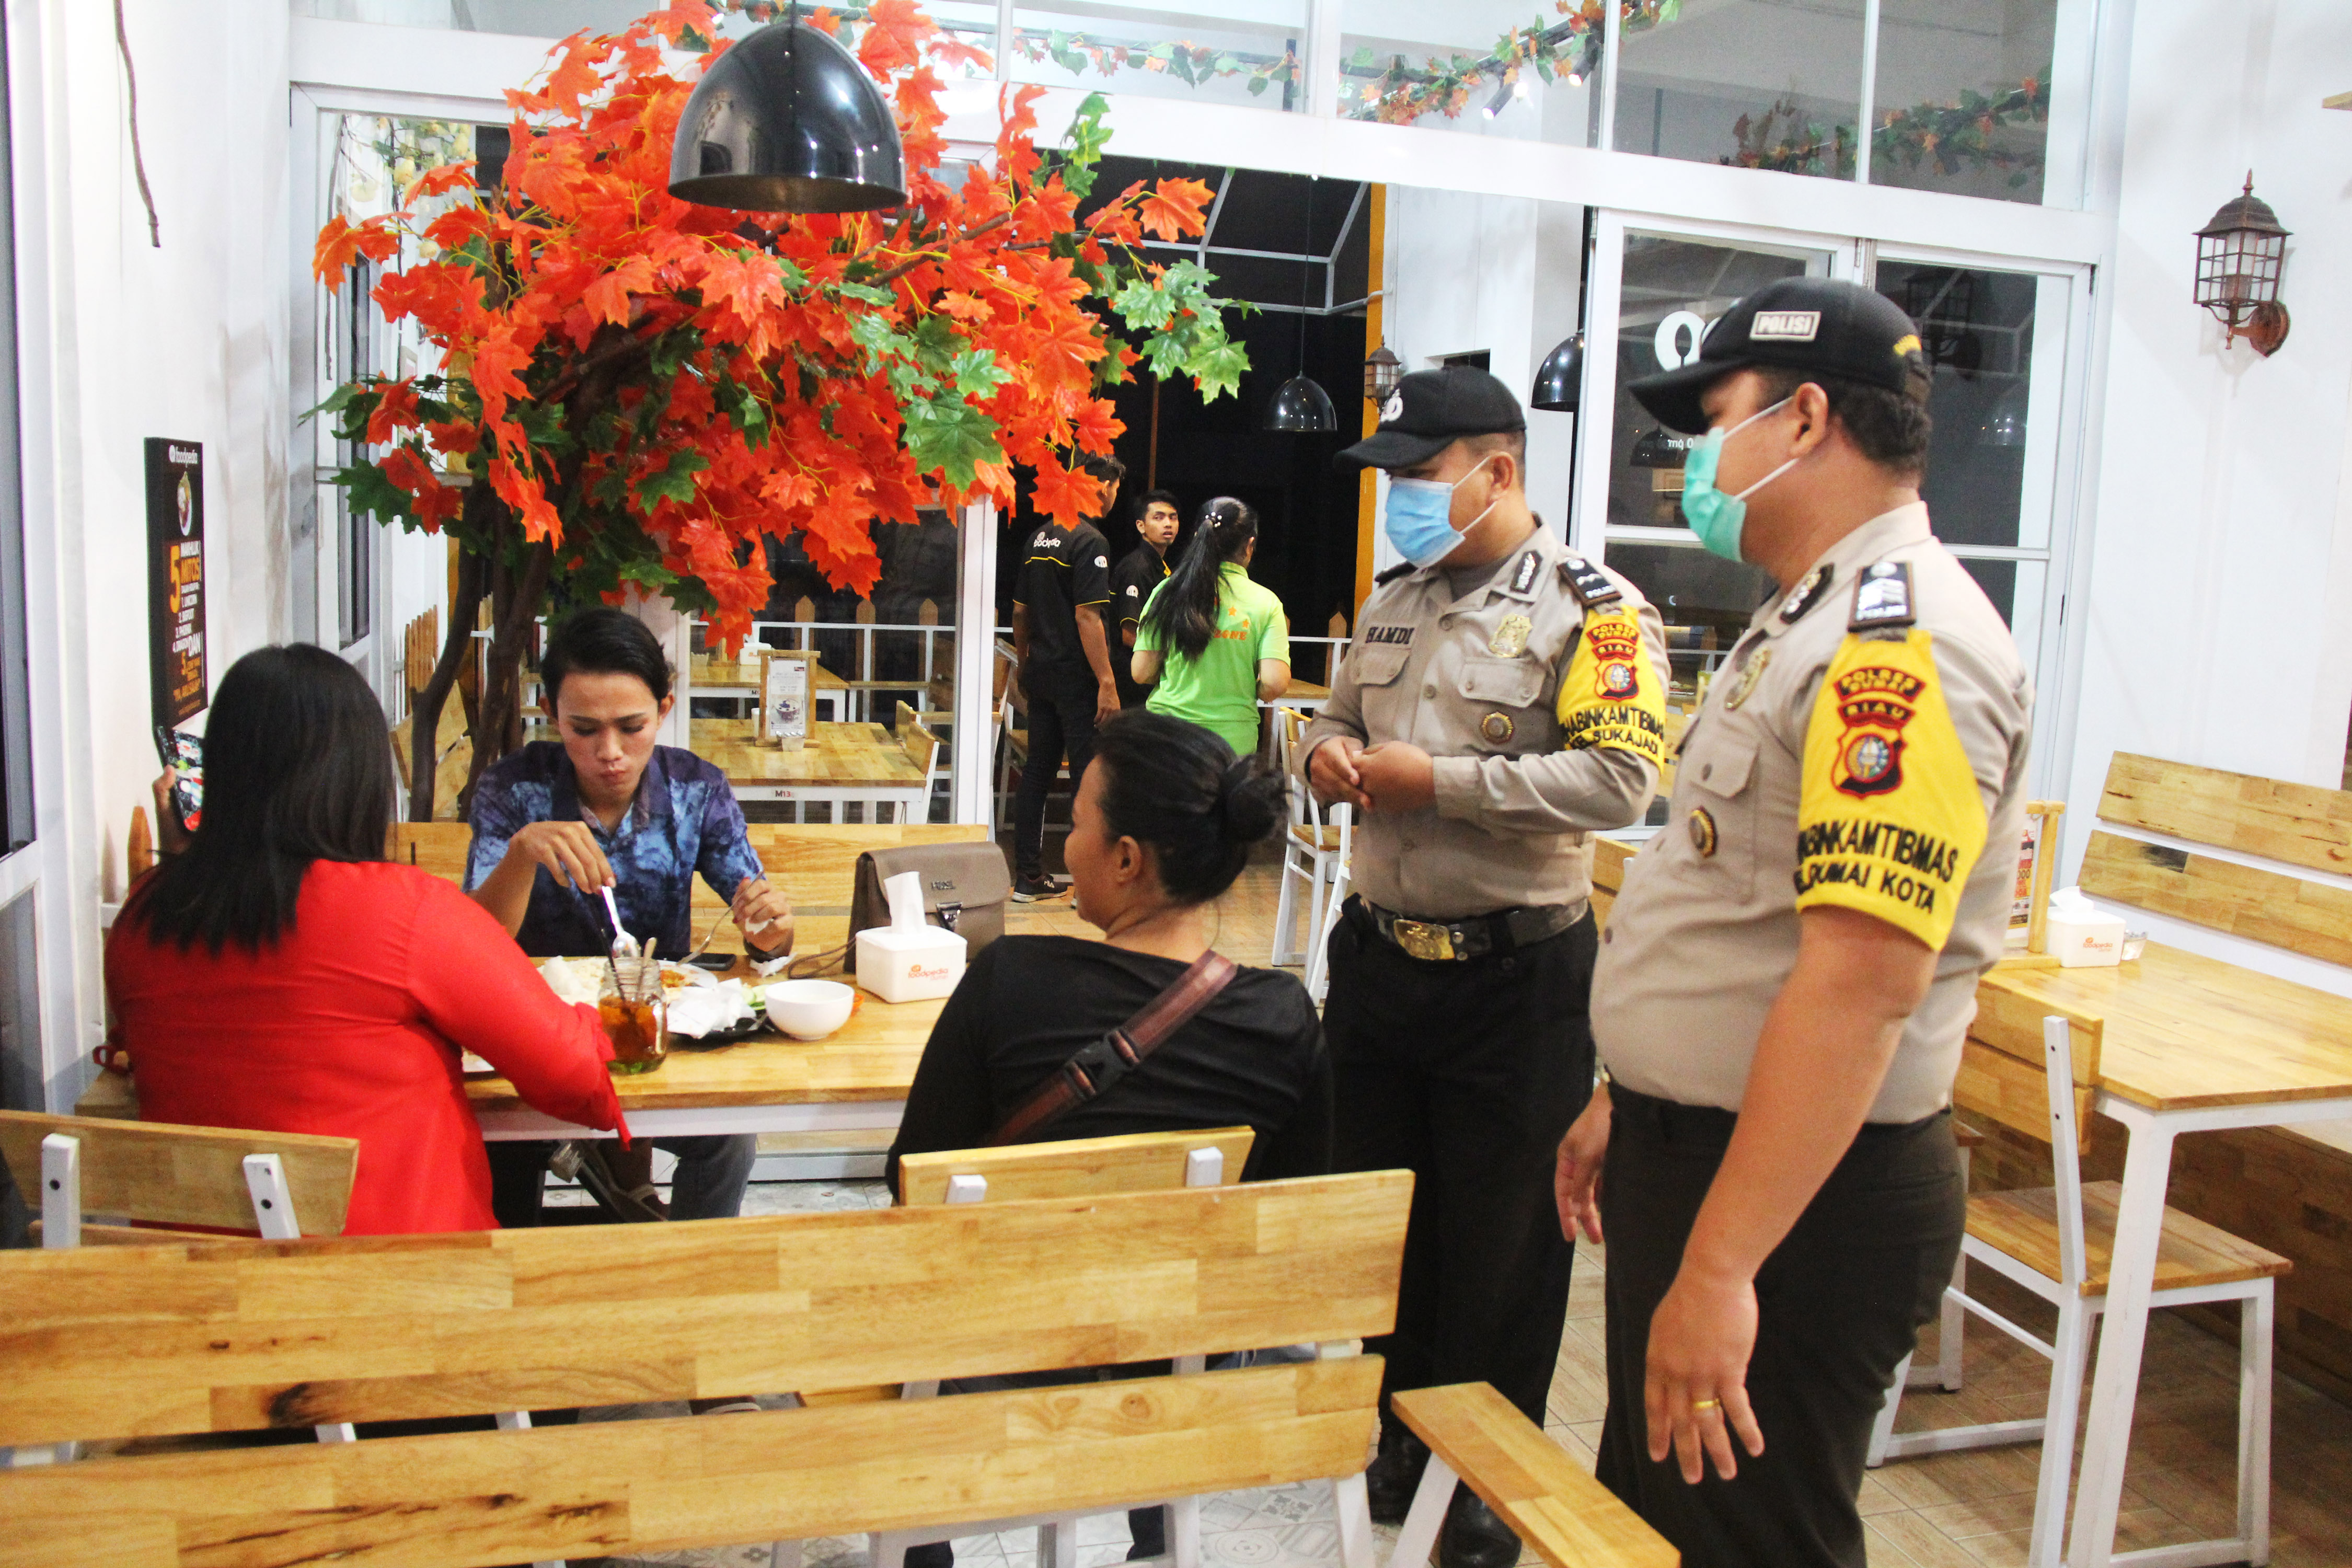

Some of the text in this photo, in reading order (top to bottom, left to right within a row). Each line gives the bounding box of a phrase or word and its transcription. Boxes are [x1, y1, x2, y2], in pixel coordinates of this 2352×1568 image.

[1758, 316, 1812, 333] POLISI
[169, 545, 180, 613] 5
[1365, 627, 1415, 644] HAMDI
[1598, 644, 1634, 654] RIAU
[1847, 702, 1905, 718] RIAU
[1880, 868, 1934, 914] KOTA
[908, 968, 949, 978] foodpedia
